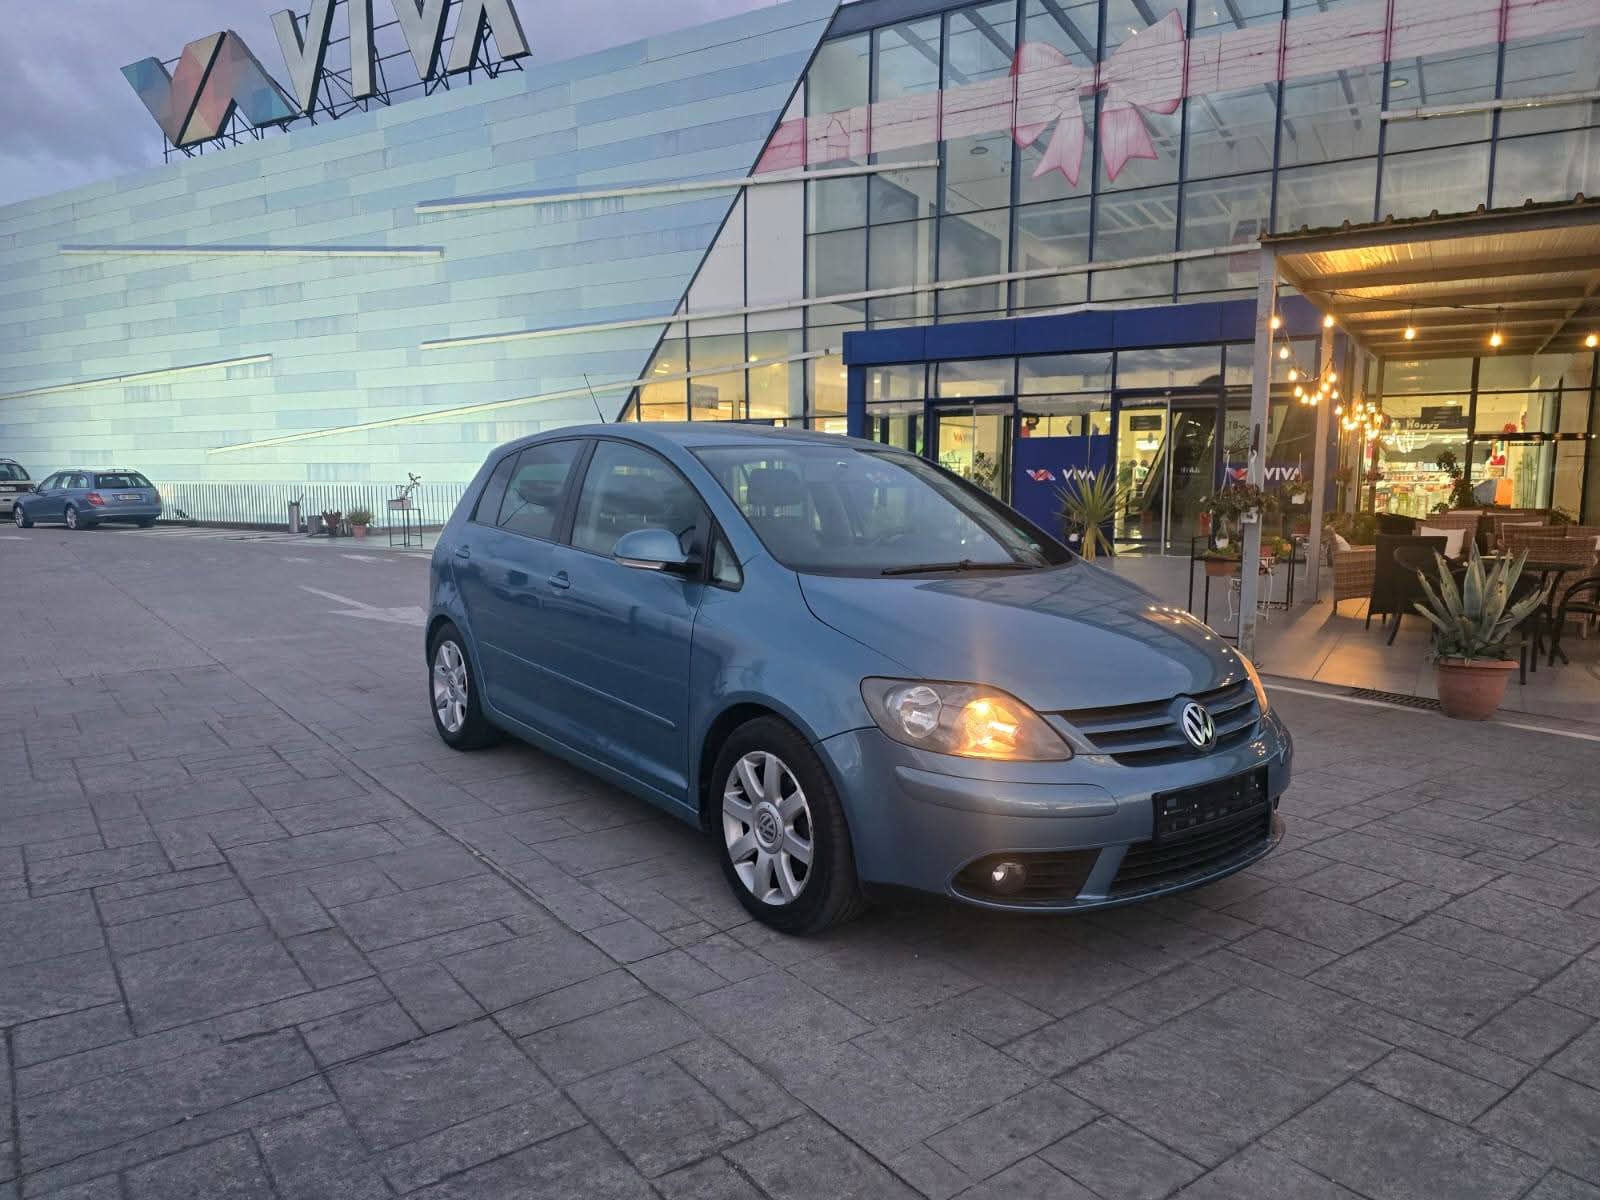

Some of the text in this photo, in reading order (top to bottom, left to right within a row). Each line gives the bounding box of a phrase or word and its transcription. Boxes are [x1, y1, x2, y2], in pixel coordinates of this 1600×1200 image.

[270, 0, 532, 114] VIVA
[1062, 469, 1095, 481] VIVA
[1264, 467, 1300, 481] VIVA
